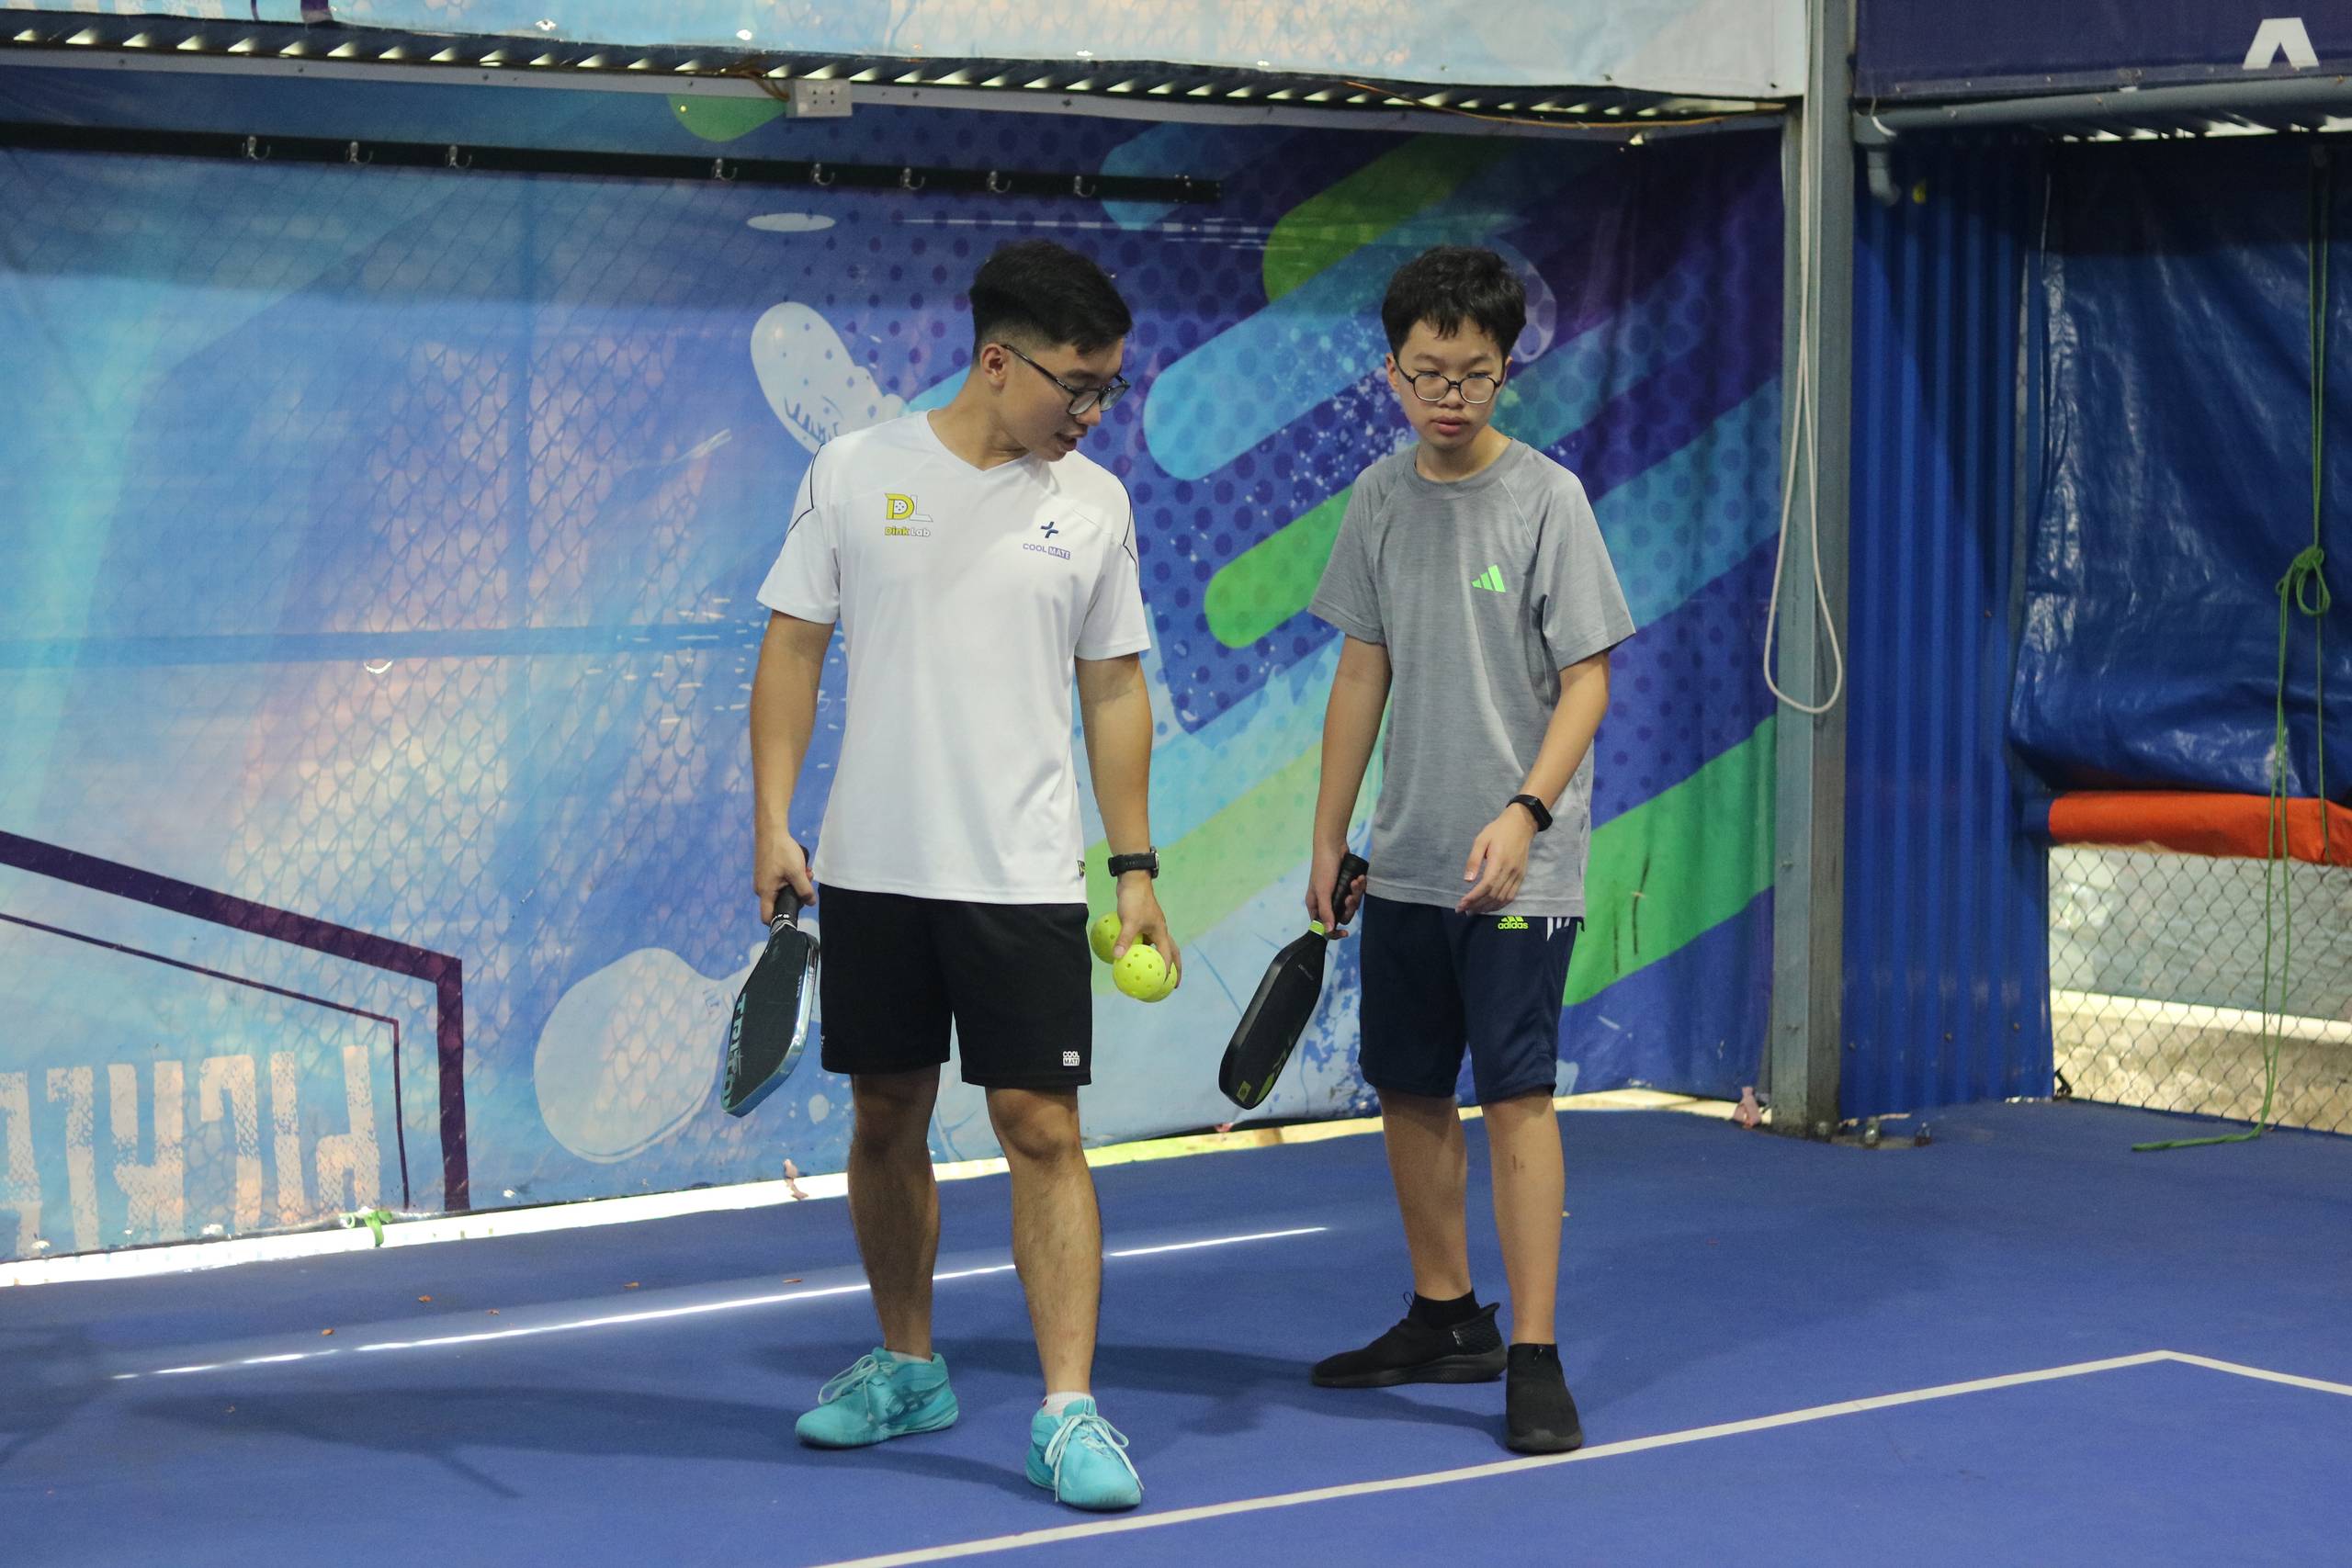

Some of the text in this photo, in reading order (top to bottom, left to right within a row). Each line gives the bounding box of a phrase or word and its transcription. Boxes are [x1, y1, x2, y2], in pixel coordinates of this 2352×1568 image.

[885, 526, 931, 536] Dink Lab
[1498, 921, 1529, 930] adidas
